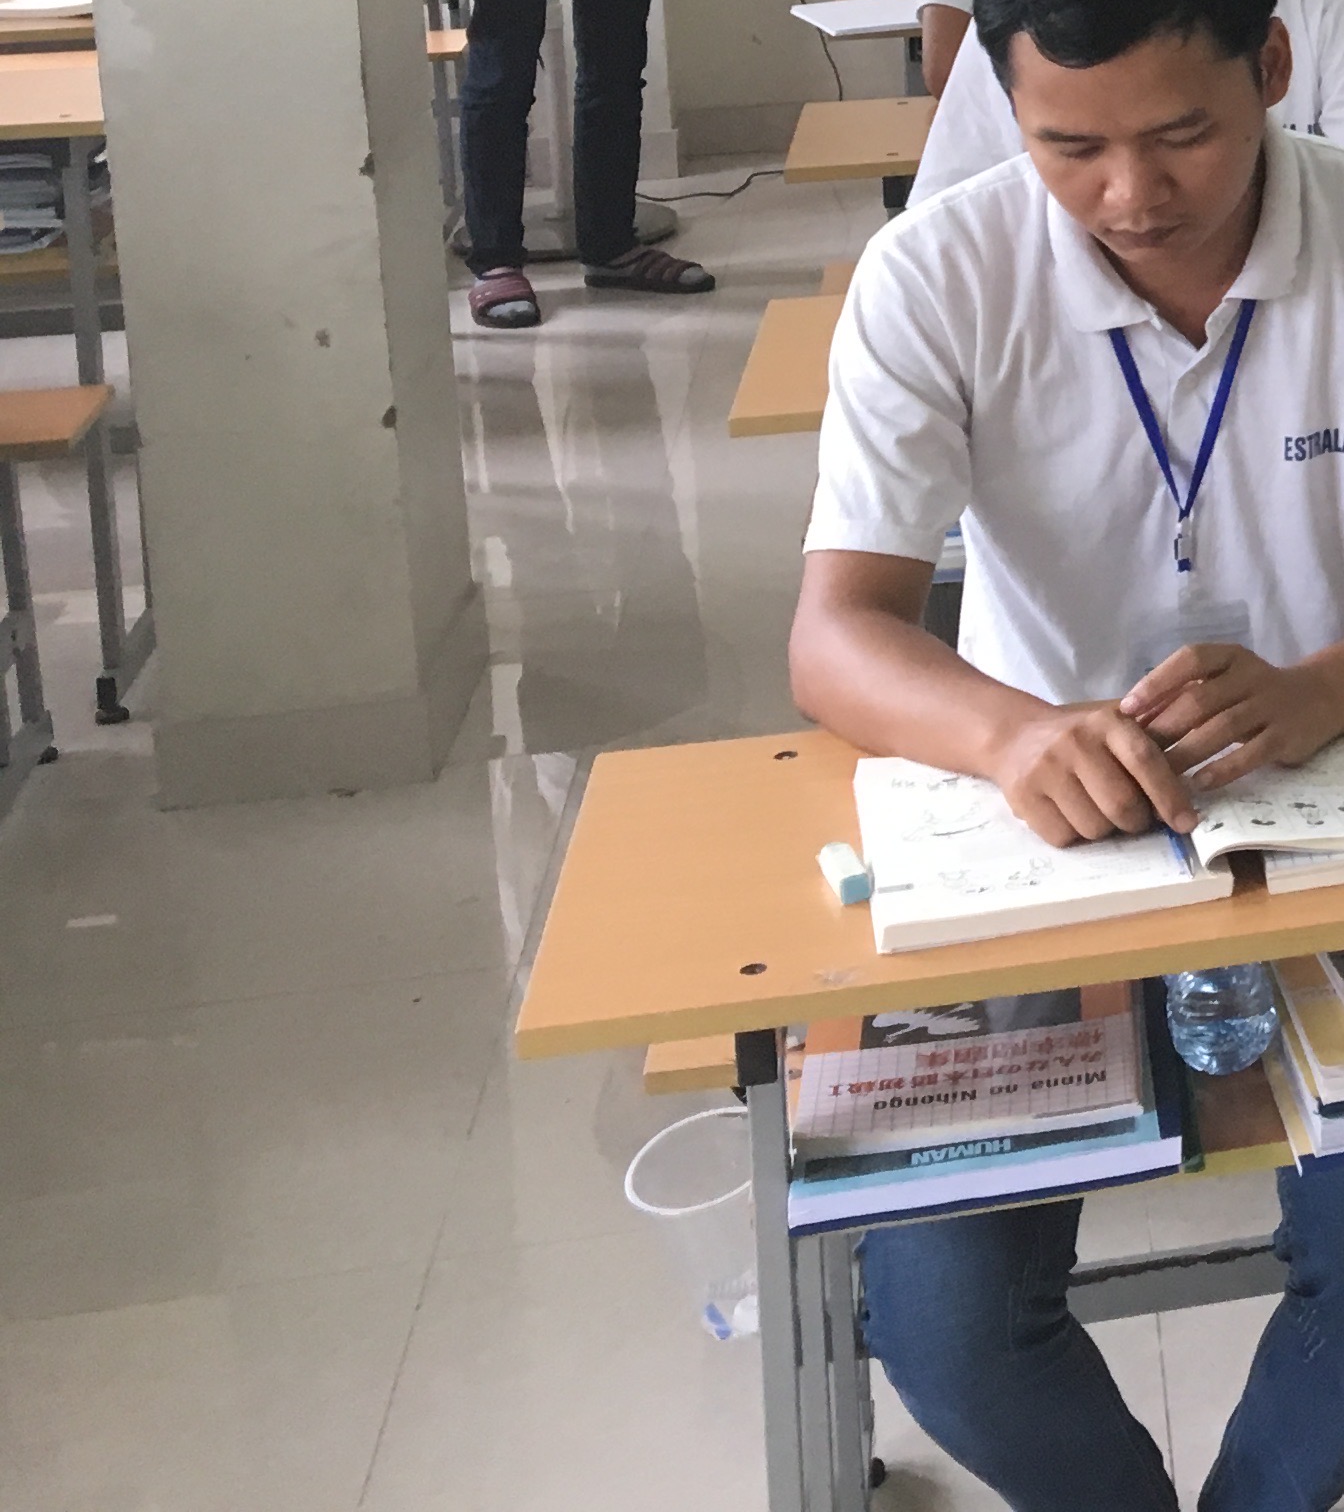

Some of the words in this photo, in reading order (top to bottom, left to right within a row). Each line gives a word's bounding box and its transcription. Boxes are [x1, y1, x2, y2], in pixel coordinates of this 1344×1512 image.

[989, 1082, 1018, 1095] no
[1031, 1070, 1107, 1090] Minna
[873, 1089, 977, 1110] Nihongo
[911, 1138, 1011, 1165] HUMAN
